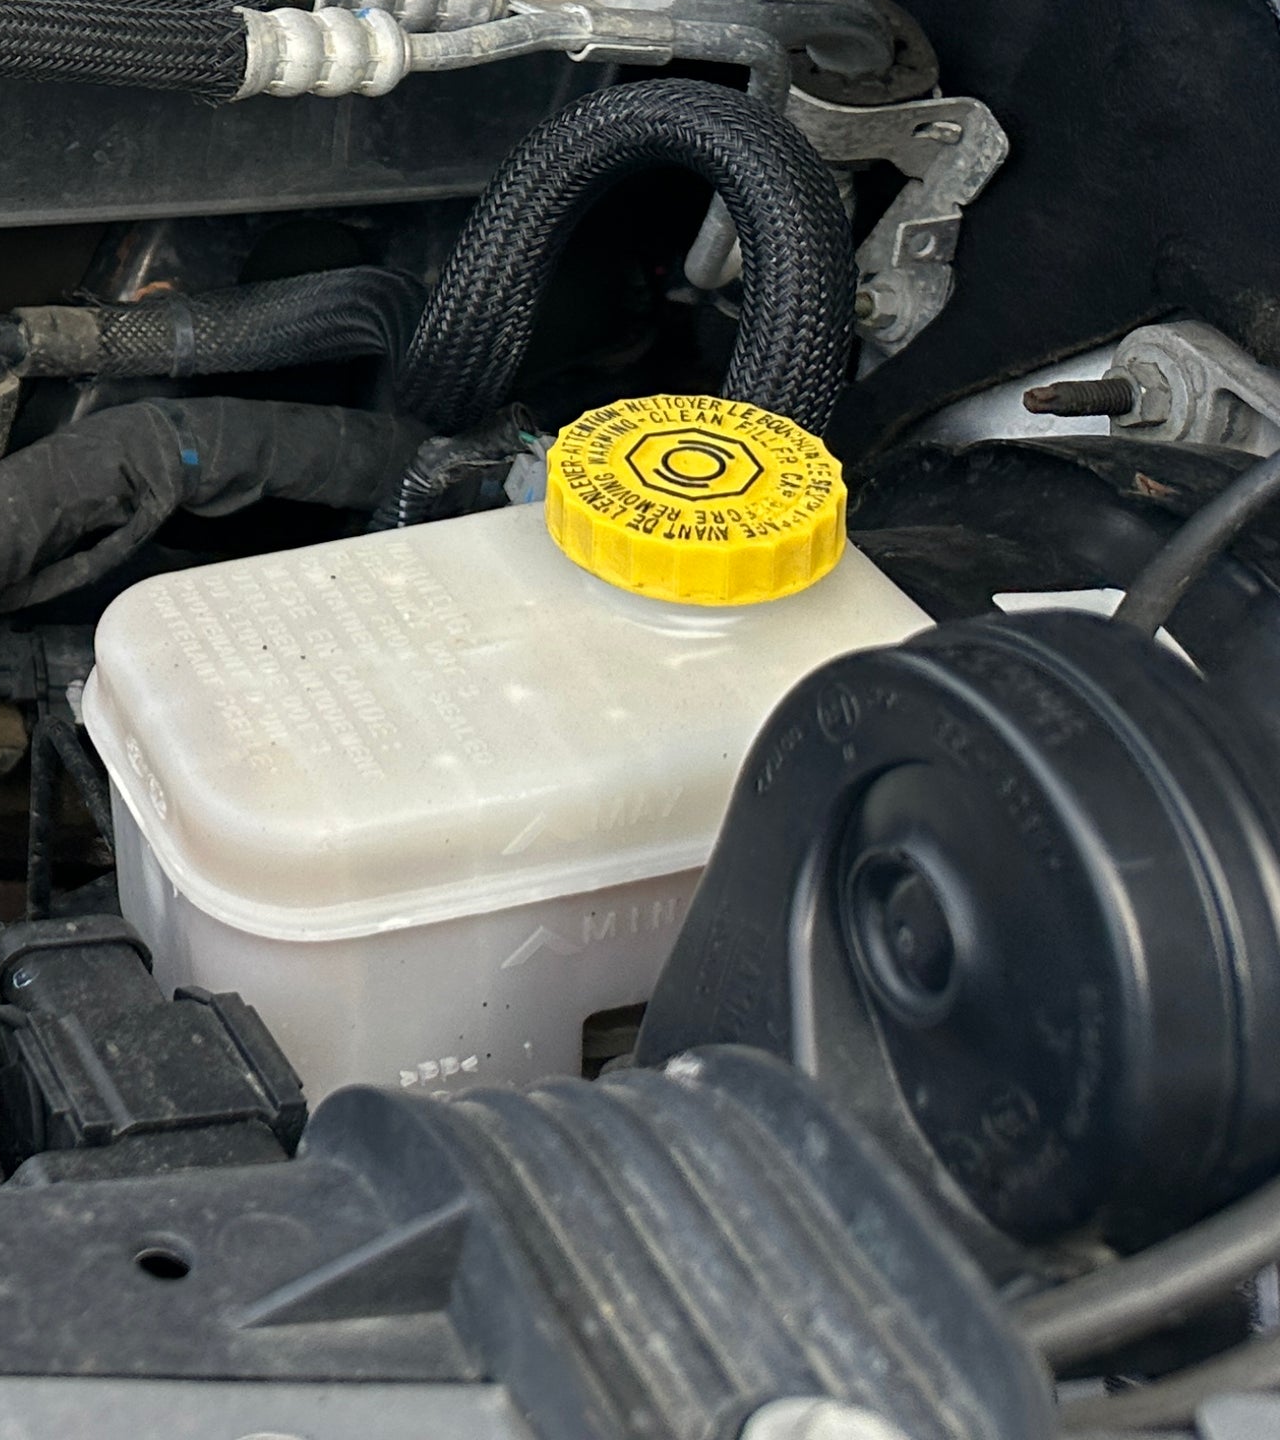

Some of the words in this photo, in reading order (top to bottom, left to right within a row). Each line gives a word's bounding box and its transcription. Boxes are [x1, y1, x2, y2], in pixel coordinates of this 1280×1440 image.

[727, 404, 757, 421] LE
[587, 418, 640, 466] WARNING
[593, 472, 681, 523] REMOVING
[625, 513, 659, 535] DE
[663, 523, 729, 541] AVANT
[583, 897, 681, 944] MIN
